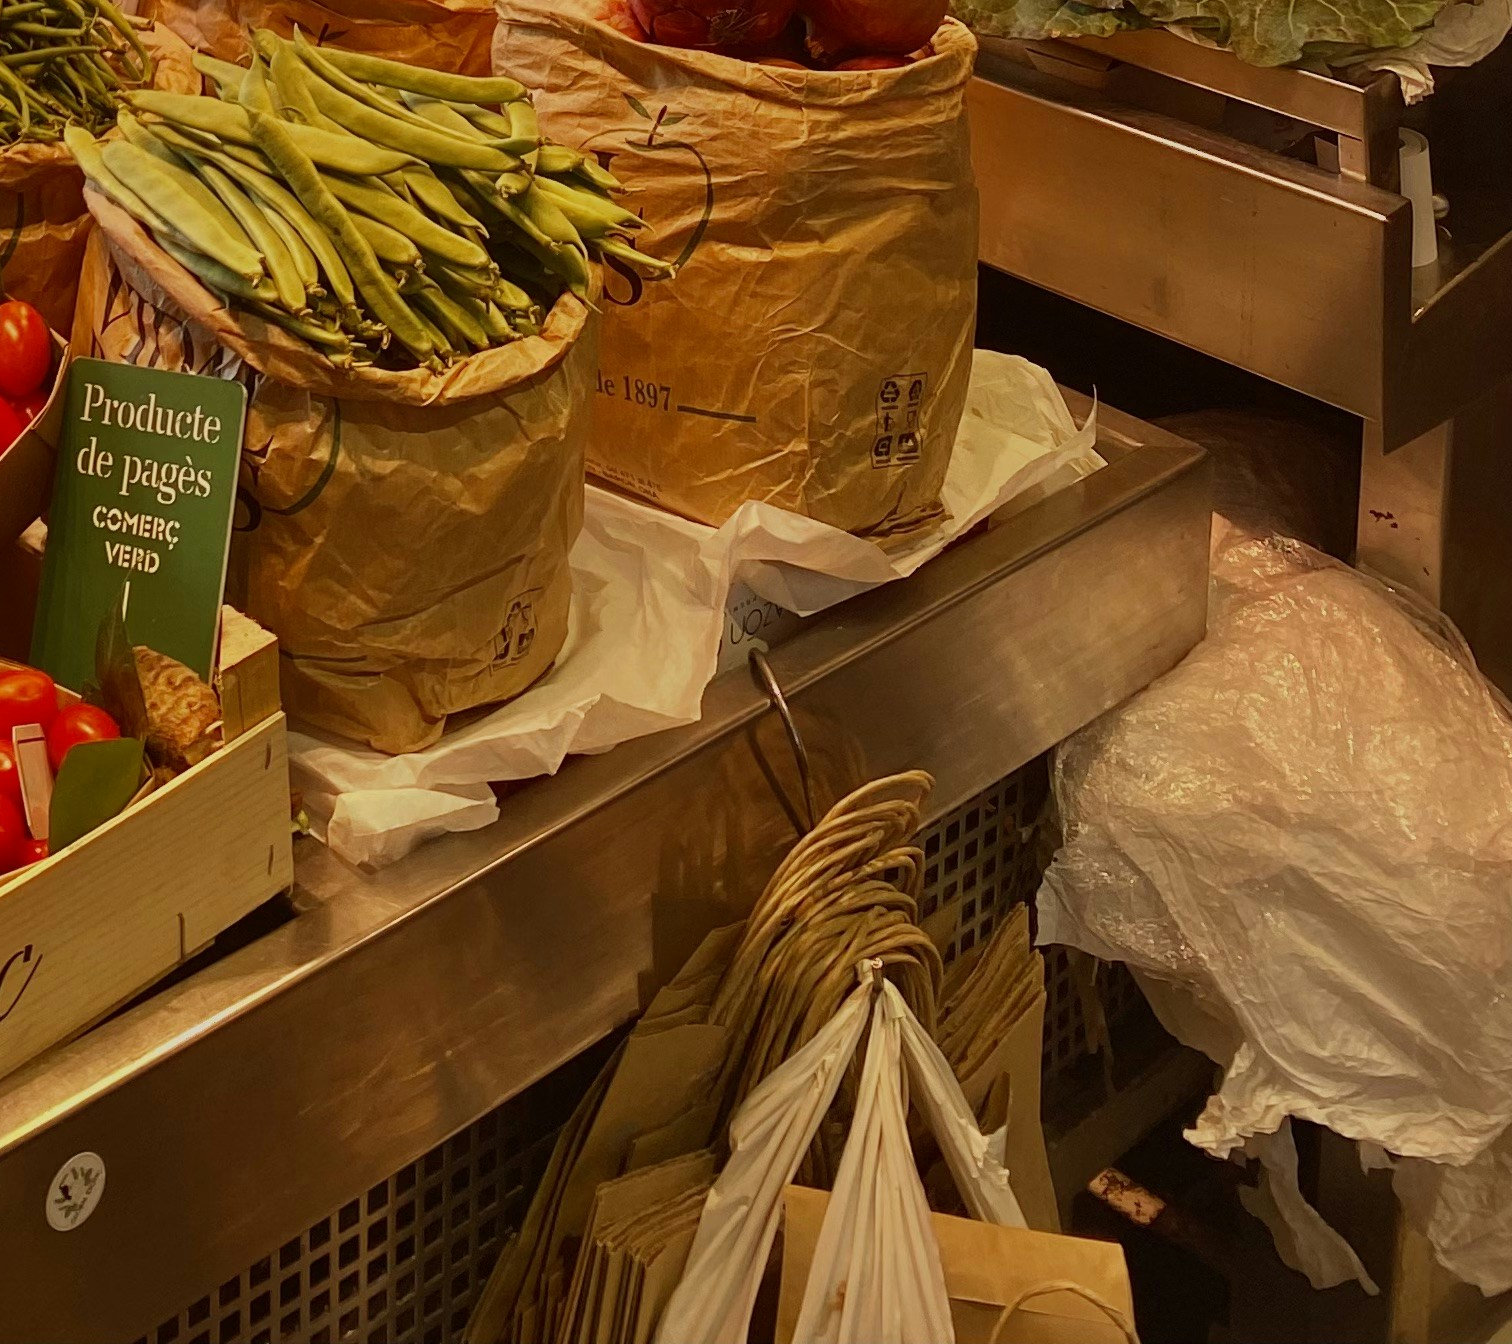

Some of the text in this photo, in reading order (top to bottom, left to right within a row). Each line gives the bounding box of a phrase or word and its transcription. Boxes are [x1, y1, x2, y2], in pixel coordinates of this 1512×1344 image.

[79, 382, 222, 446] Producte
[623, 375, 671, 411] 1897
[76, 436, 213, 506] de pagès
[92, 504, 181, 551] COMERÇ
[104, 540, 161, 574] VERD
